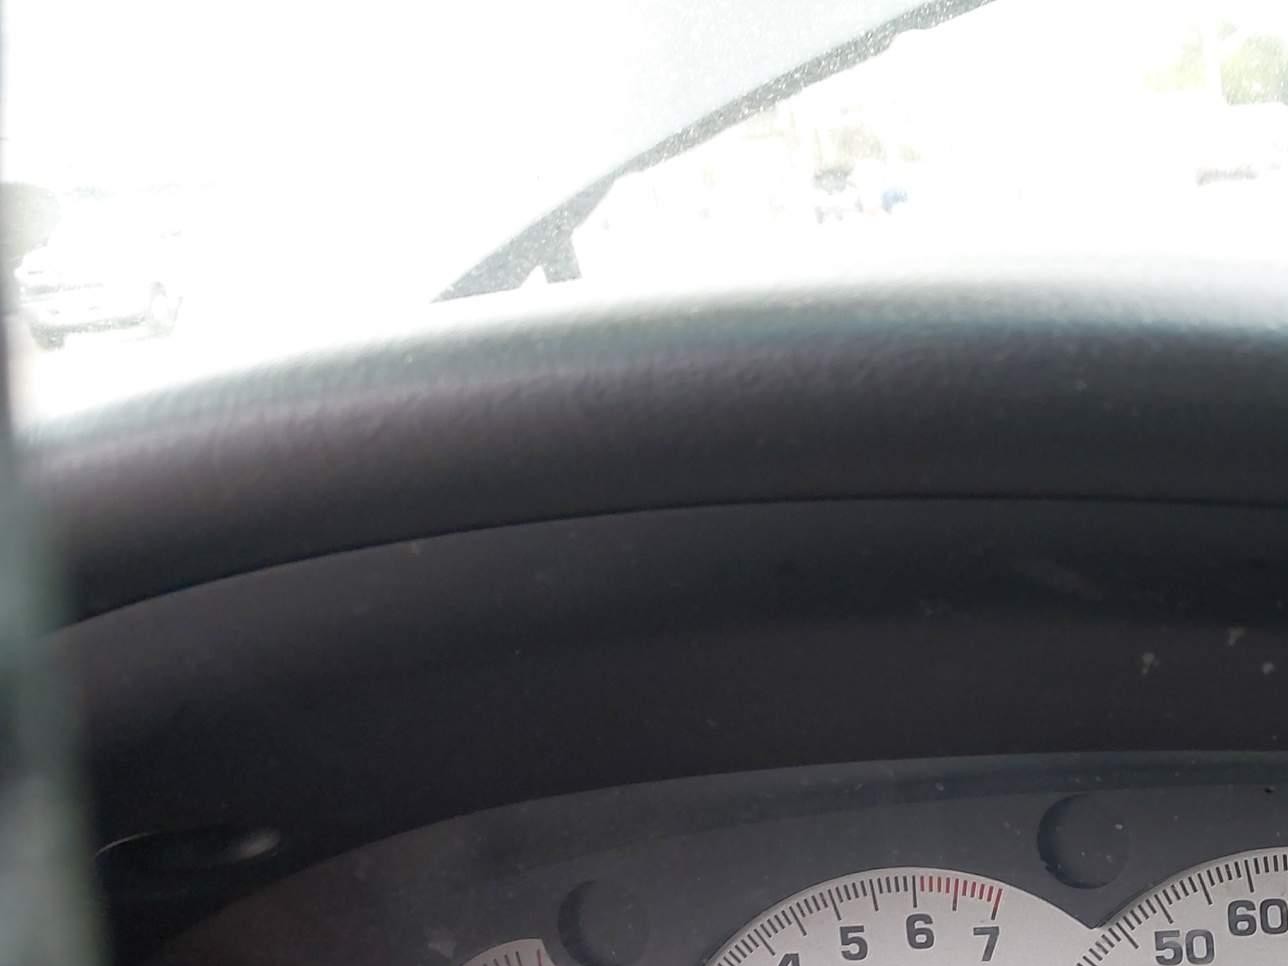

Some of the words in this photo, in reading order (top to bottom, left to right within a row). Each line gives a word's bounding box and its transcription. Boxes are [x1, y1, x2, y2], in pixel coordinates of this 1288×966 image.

[840, 925, 868, 960] 5
[905, 914, 935, 949] 6
[972, 926, 999, 962] 7
[1154, 929, 1215, 966] 50
